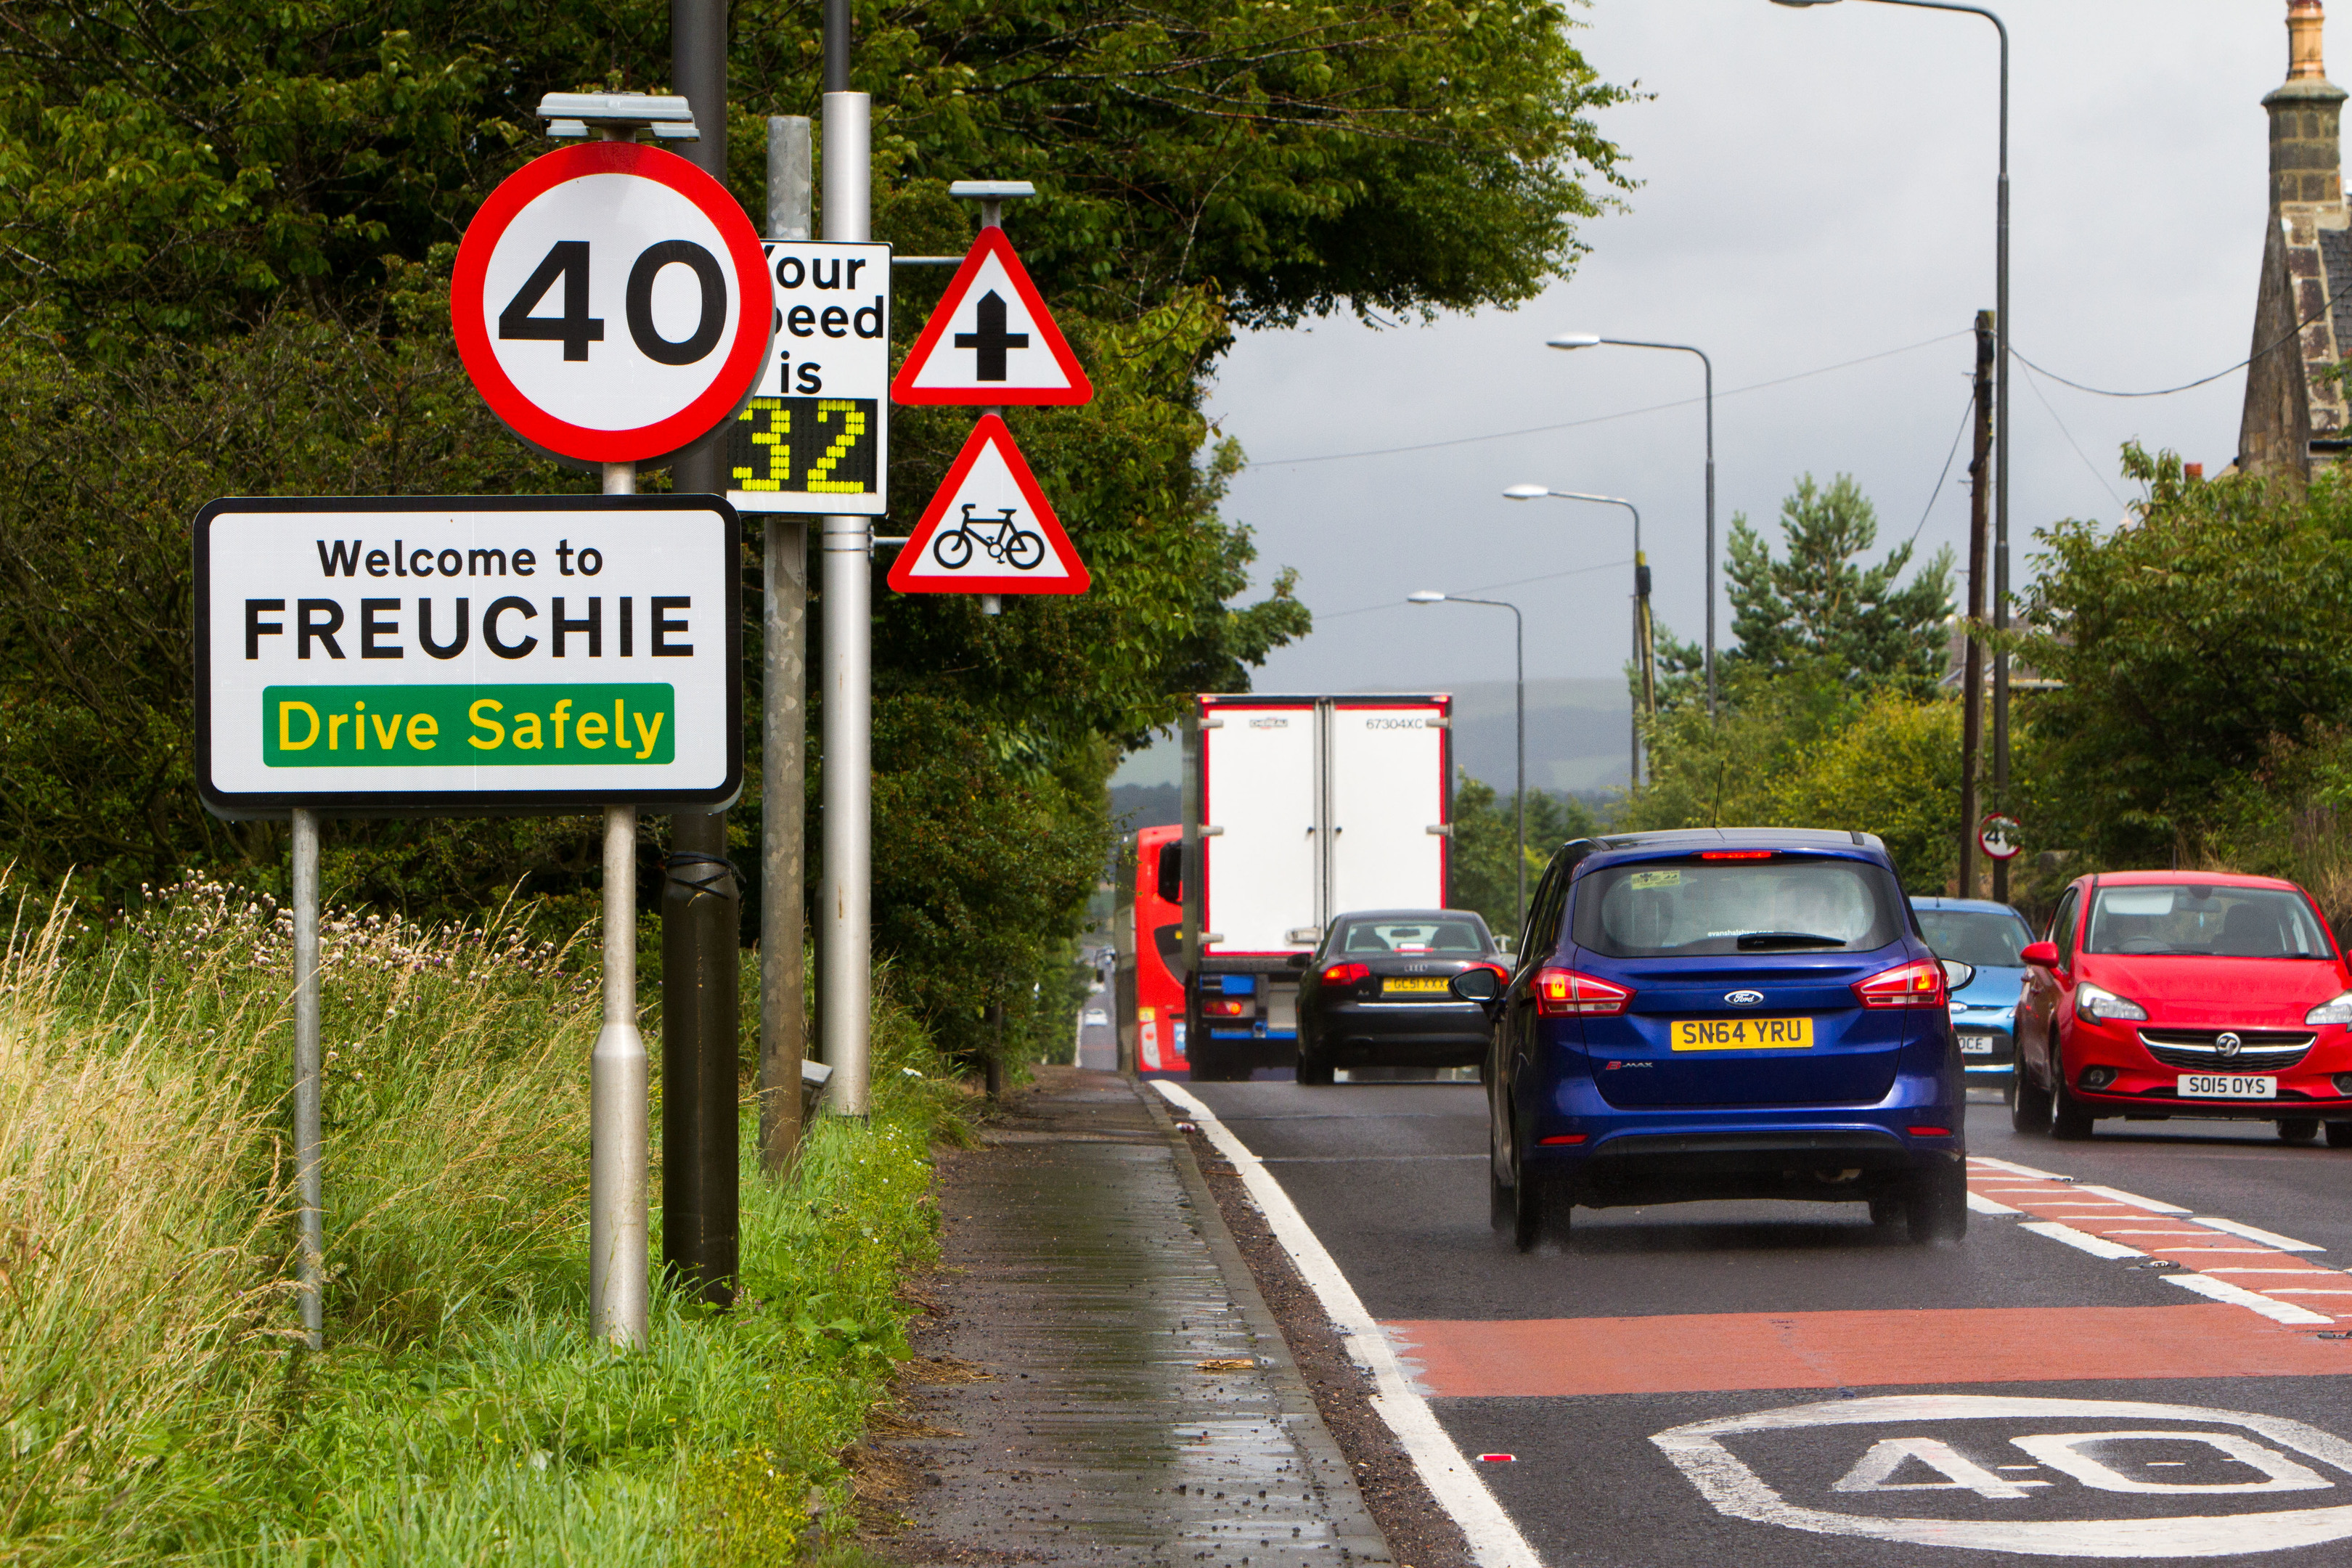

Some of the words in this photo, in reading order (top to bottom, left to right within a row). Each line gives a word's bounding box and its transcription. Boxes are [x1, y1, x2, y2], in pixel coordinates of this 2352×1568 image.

[764, 245, 866, 290] our
[498, 240, 727, 366] 40
[775, 295, 883, 338] eed
[780, 351, 822, 394] is
[732, 398, 865, 494] 32
[317, 539, 536, 578] Welcome
[556, 539, 603, 576] to
[245, 596, 695, 660] FREUCHIE
[278, 701, 439, 751] Drive
[467, 699, 665, 759] Safely
[1367, 718, 1423, 730] 67304XC
[1734, 992, 1755, 1003] Ford
[1682, 1022, 1746, 1045] SN64
[1754, 1020, 1802, 1042] YRU
[2189, 1077, 2227, 1093] SO15
[2232, 1078, 2266, 1094] OYS
[1832, 1430, 2335, 1498] 40
